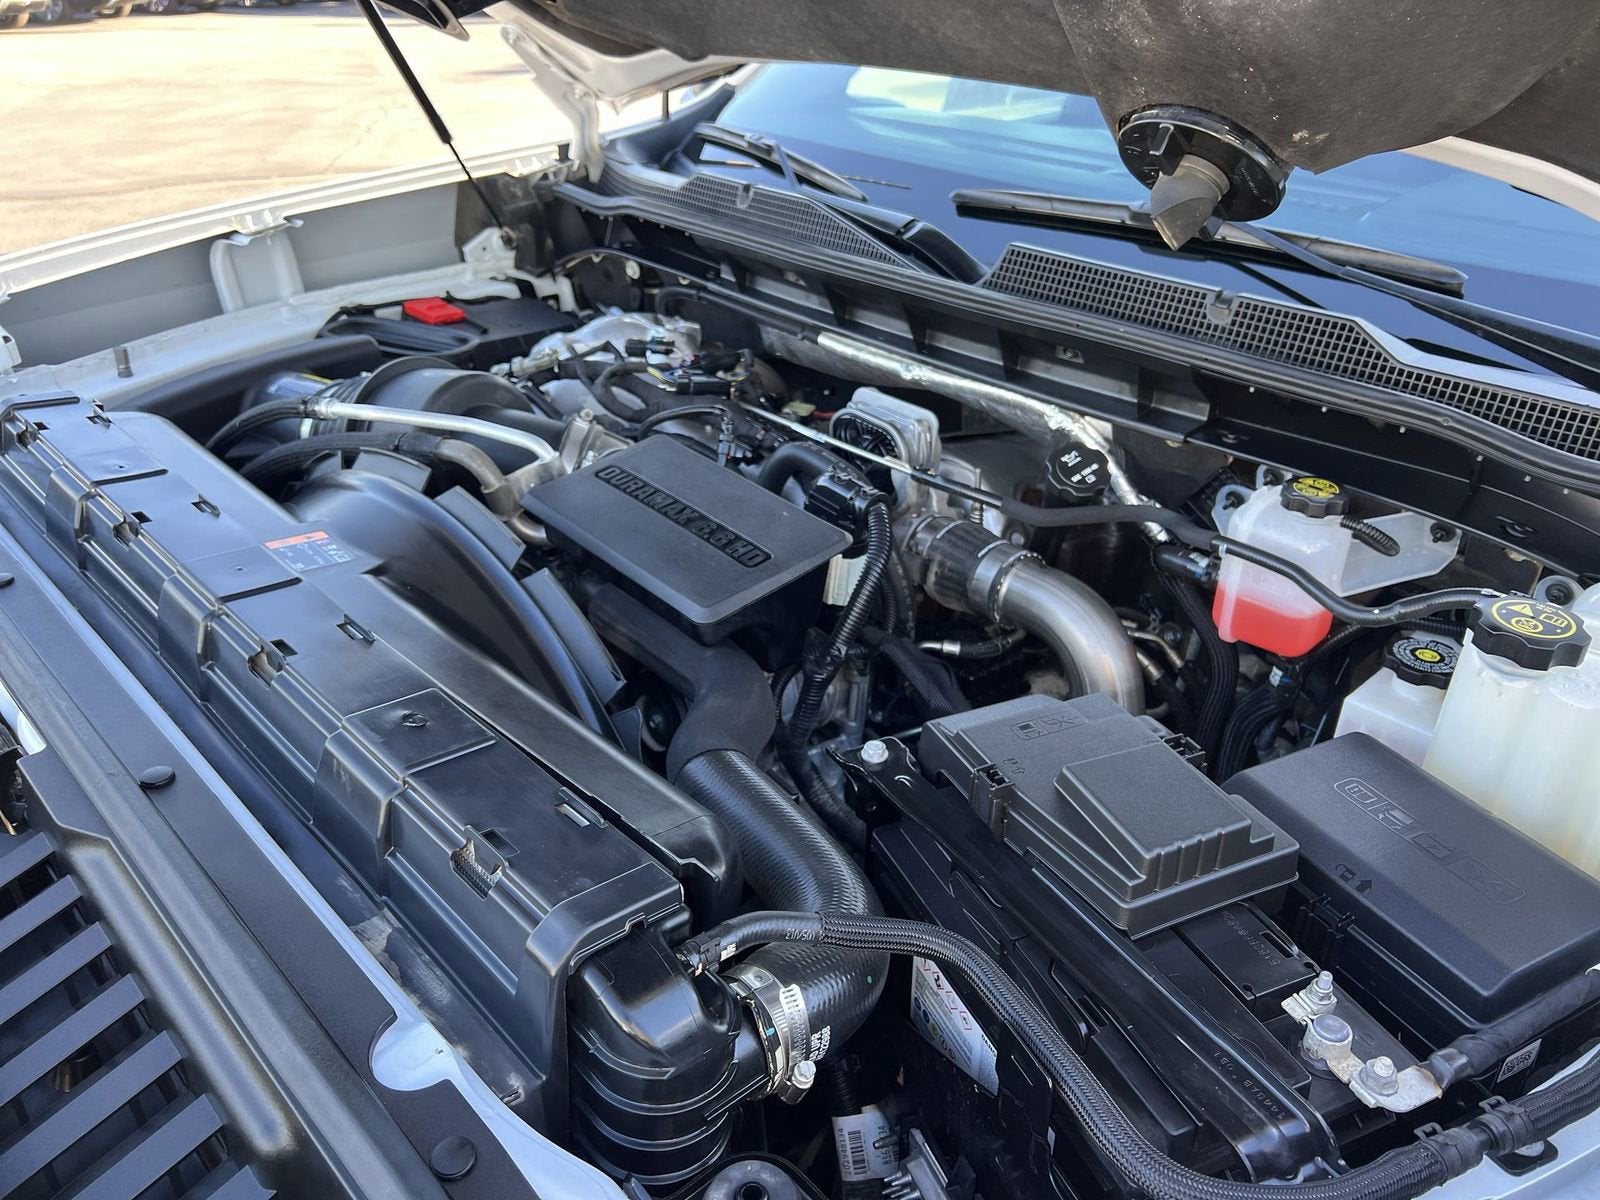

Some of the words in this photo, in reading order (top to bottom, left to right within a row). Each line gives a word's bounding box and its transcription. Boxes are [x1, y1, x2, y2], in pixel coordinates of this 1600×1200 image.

[598, 466, 699, 525] DURAMAX
[692, 521, 735, 545] 6.6
[725, 537, 770, 567] HD
